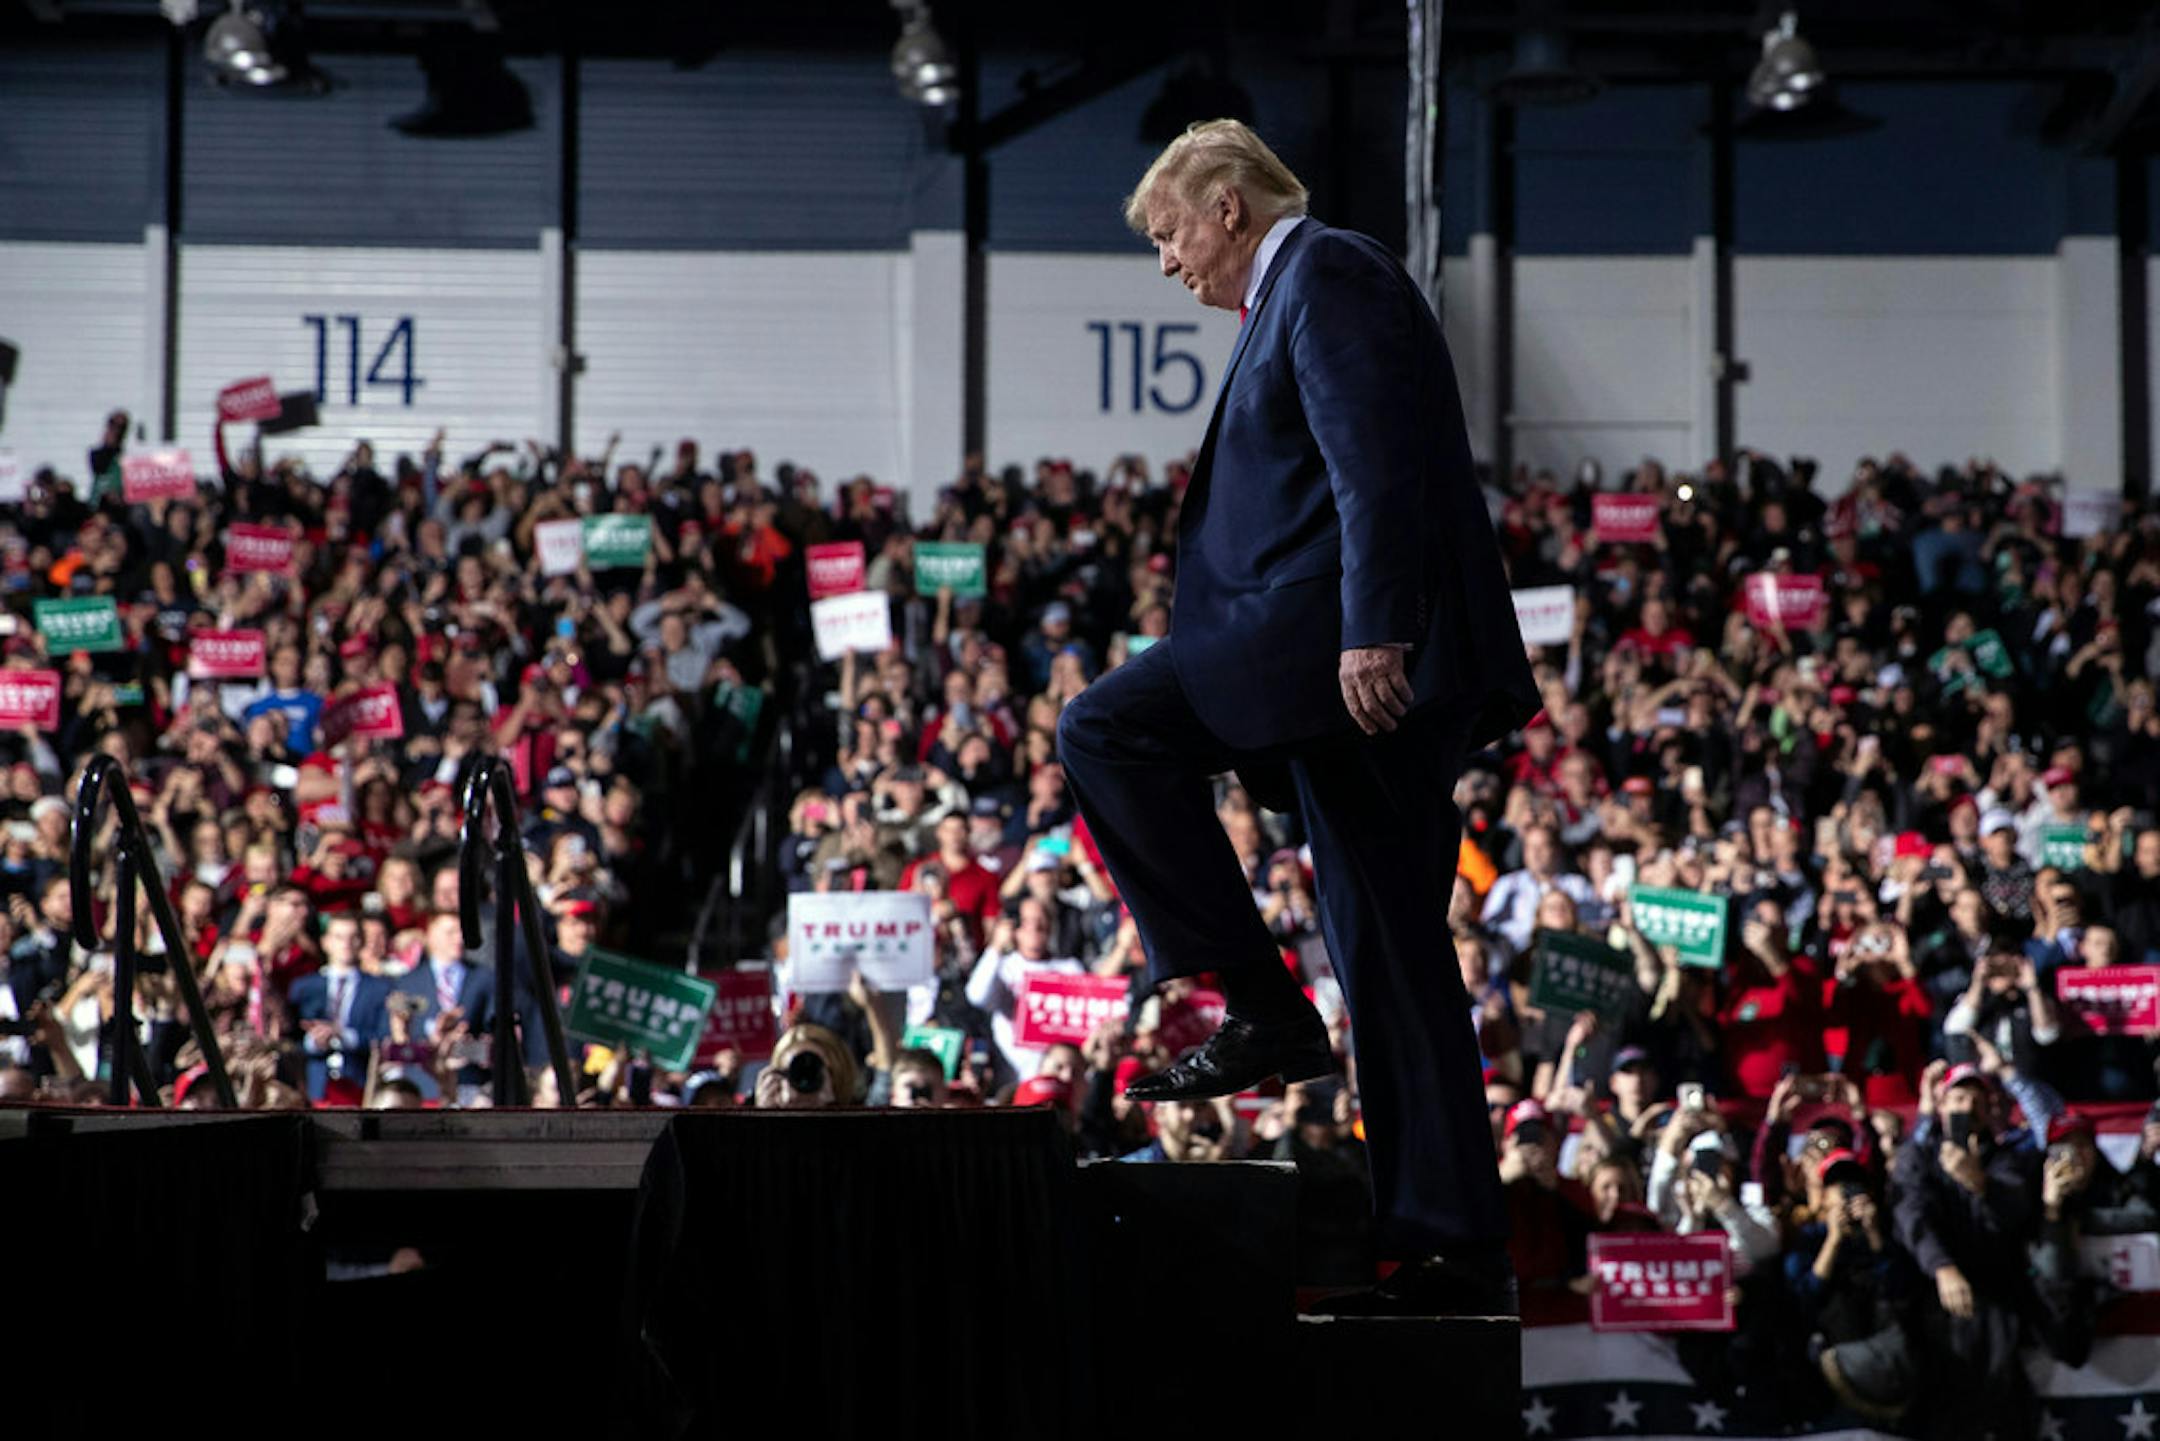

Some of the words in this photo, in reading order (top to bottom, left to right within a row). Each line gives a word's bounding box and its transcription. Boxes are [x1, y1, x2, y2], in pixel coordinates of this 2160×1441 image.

[302, 314, 424, 406] 114
[1086, 321, 1206, 414] 115
[803, 921, 923, 939] TRUMP
[585, 974, 702, 1022] TRUMP
[1025, 992, 1129, 1019] TRUMP
[1600, 1260, 1723, 1284] TRUMP
